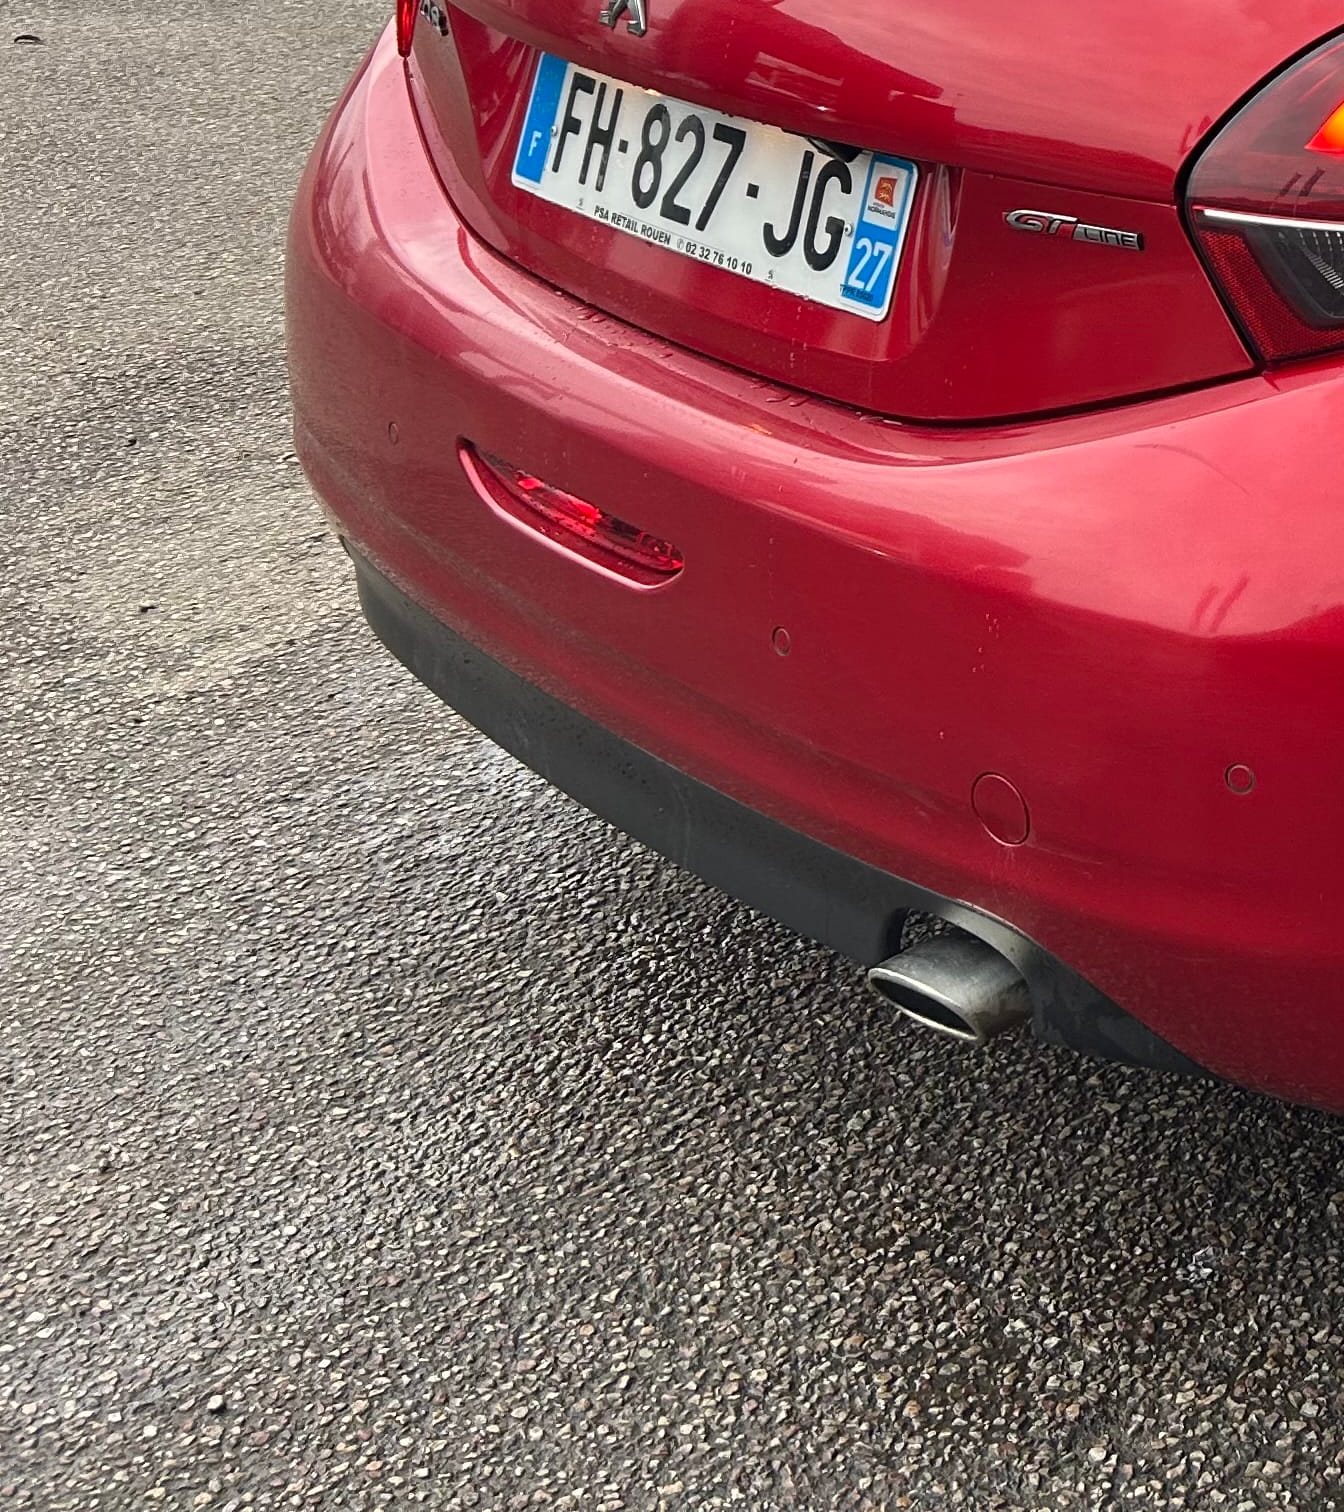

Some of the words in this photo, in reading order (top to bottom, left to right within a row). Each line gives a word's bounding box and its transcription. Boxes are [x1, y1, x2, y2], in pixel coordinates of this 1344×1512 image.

[527, 130, 542, 157] F
[594, 205, 609, 222] PSA
[611, 212, 639, 233] RETAIL
[641, 223, 672, 246] ROUEN
[685, 241, 696, 256] 02
[698, 246, 711, 261] 32
[712, 251, 724, 265] 76
[726, 256, 738, 270] 10
[741, 261, 753, 275] 10
[1006, 209, 1078, 236] GT
[1084, 228, 1138, 248] LINE
[847, 237, 894, 292] 27
